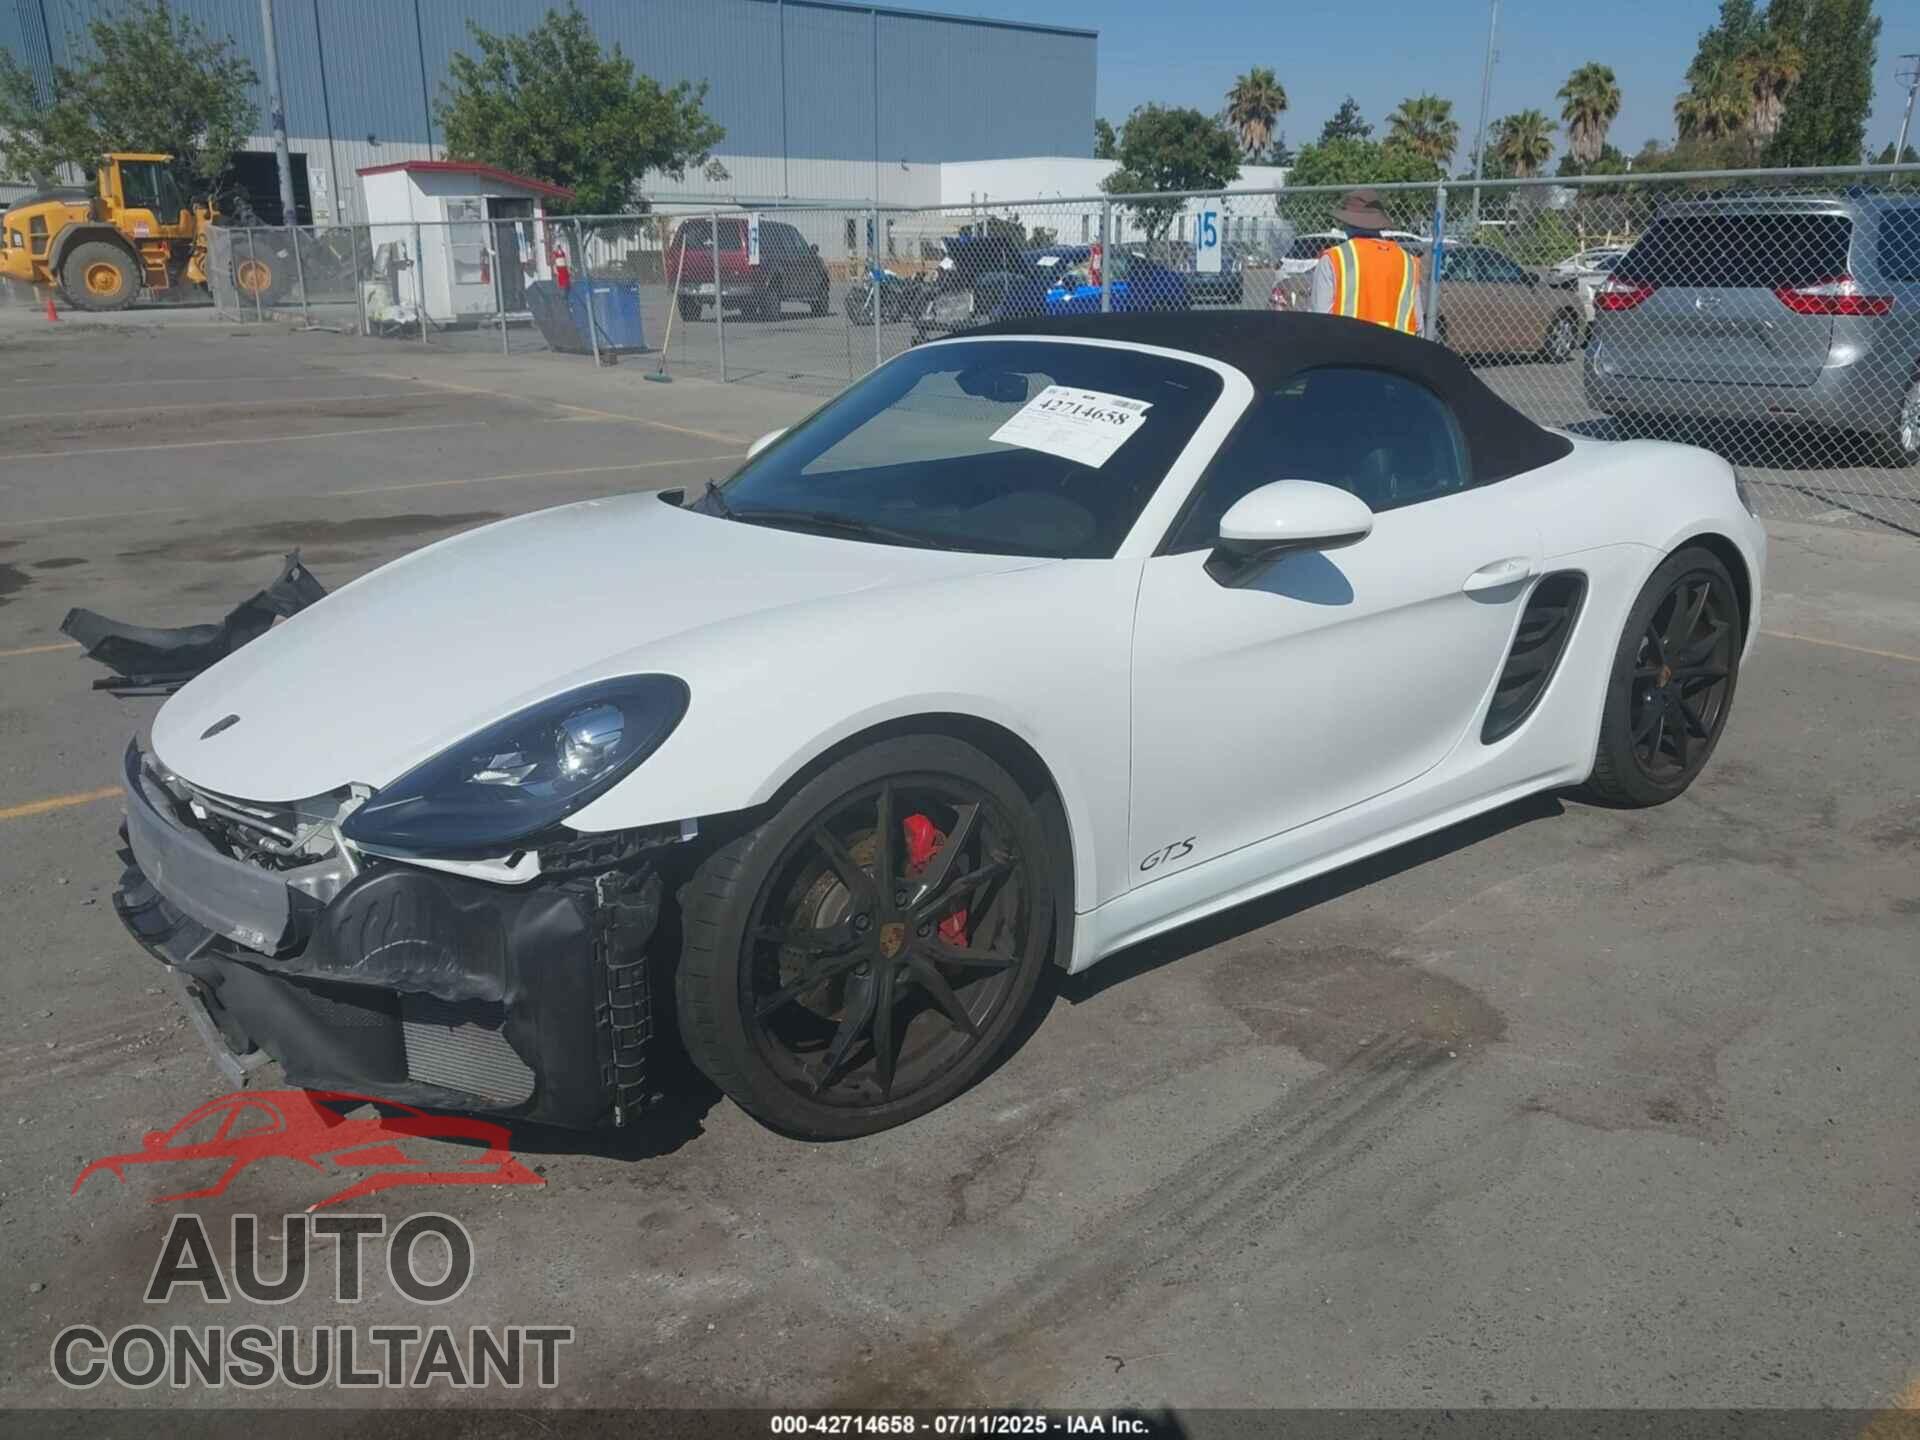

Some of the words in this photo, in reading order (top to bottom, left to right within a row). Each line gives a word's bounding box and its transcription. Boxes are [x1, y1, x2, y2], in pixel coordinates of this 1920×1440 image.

[1197, 211, 1217, 250] 15
[1039, 398, 1130, 425] 42714658
[1140, 836, 1197, 871] GTS
